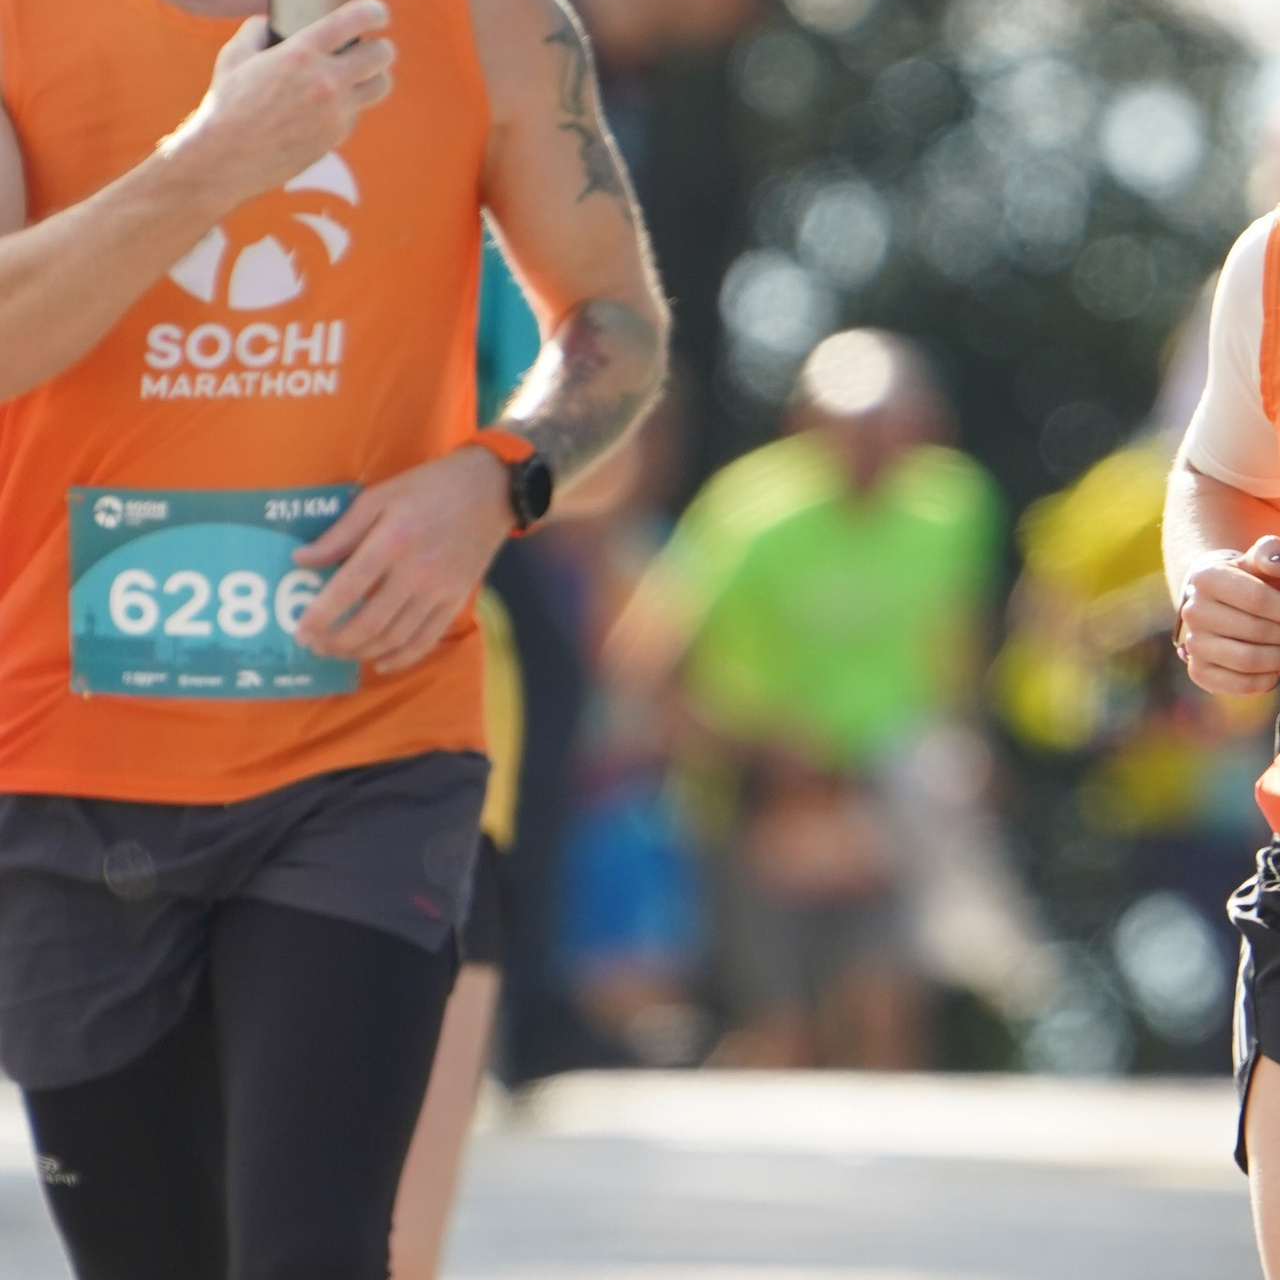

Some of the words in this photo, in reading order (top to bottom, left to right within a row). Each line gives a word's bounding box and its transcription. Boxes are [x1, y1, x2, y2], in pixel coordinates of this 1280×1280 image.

[144, 321, 342, 369] SOCHI
[140, 370, 338, 400] MARATHON
[264, 498, 300, 521] 21,1
[303, 496, 341, 517] KM
[109, 569, 324, 638] 6286
